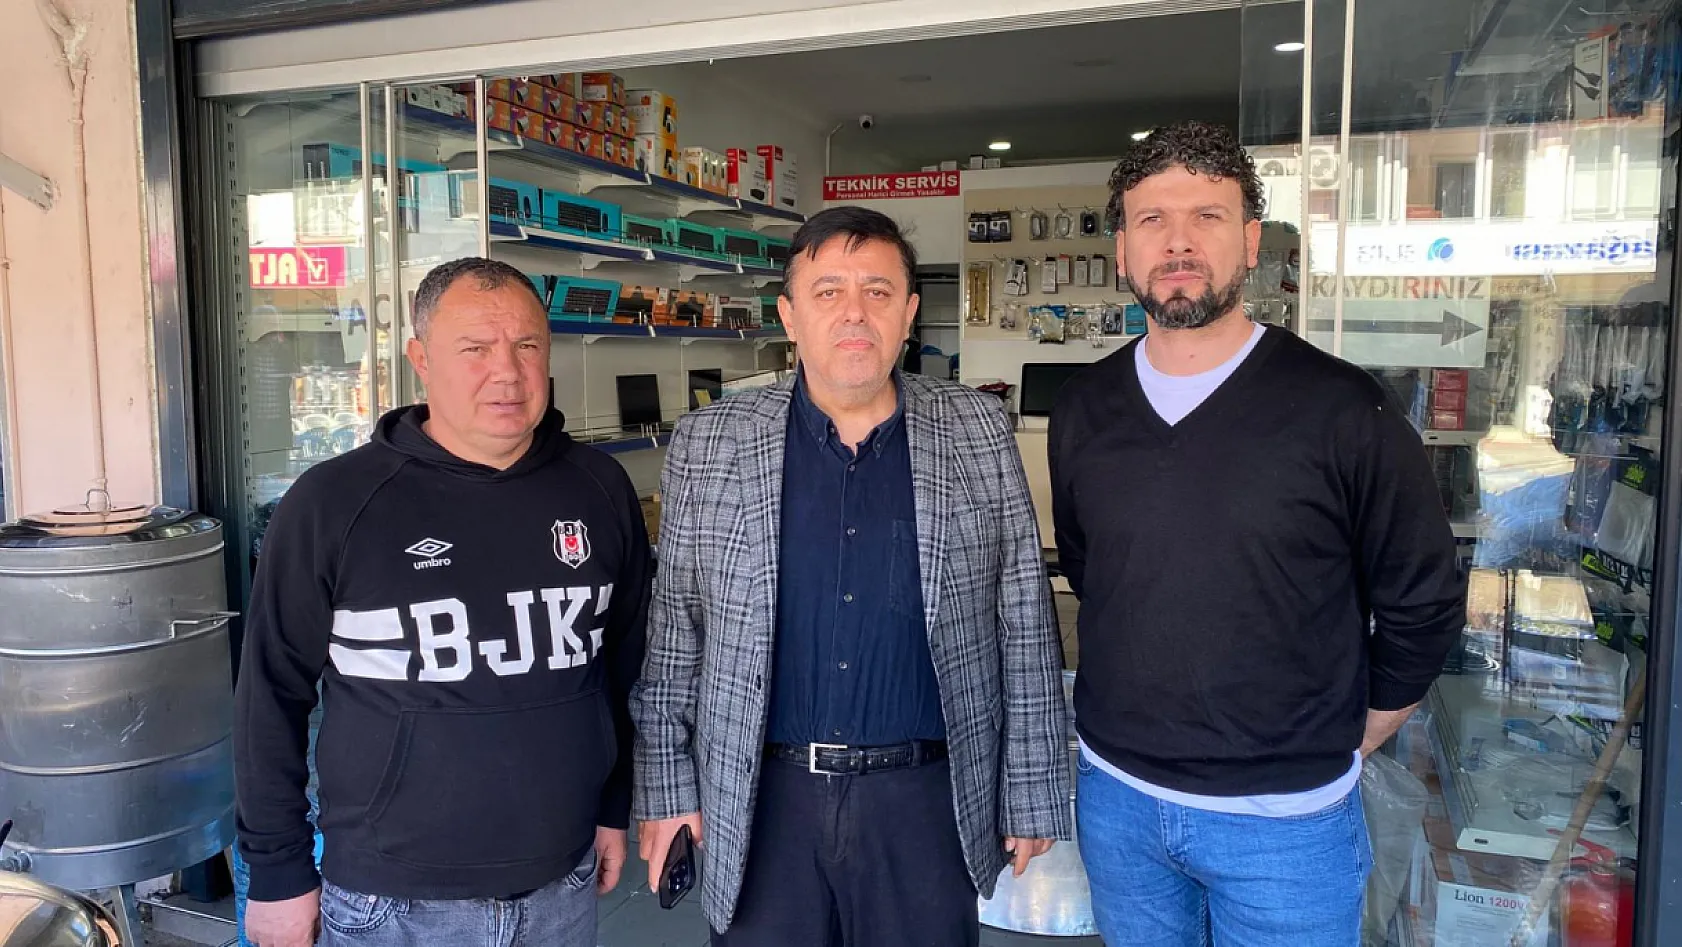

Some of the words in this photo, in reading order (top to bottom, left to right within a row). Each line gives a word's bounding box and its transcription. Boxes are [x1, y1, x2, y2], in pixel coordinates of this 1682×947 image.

[825, 175, 890, 192] TEKNİK
[895, 172, 958, 189] SERVİS
[413, 556, 452, 570] umbro
[409, 586, 593, 682] BJK
[1454, 888, 1485, 905] Lion
